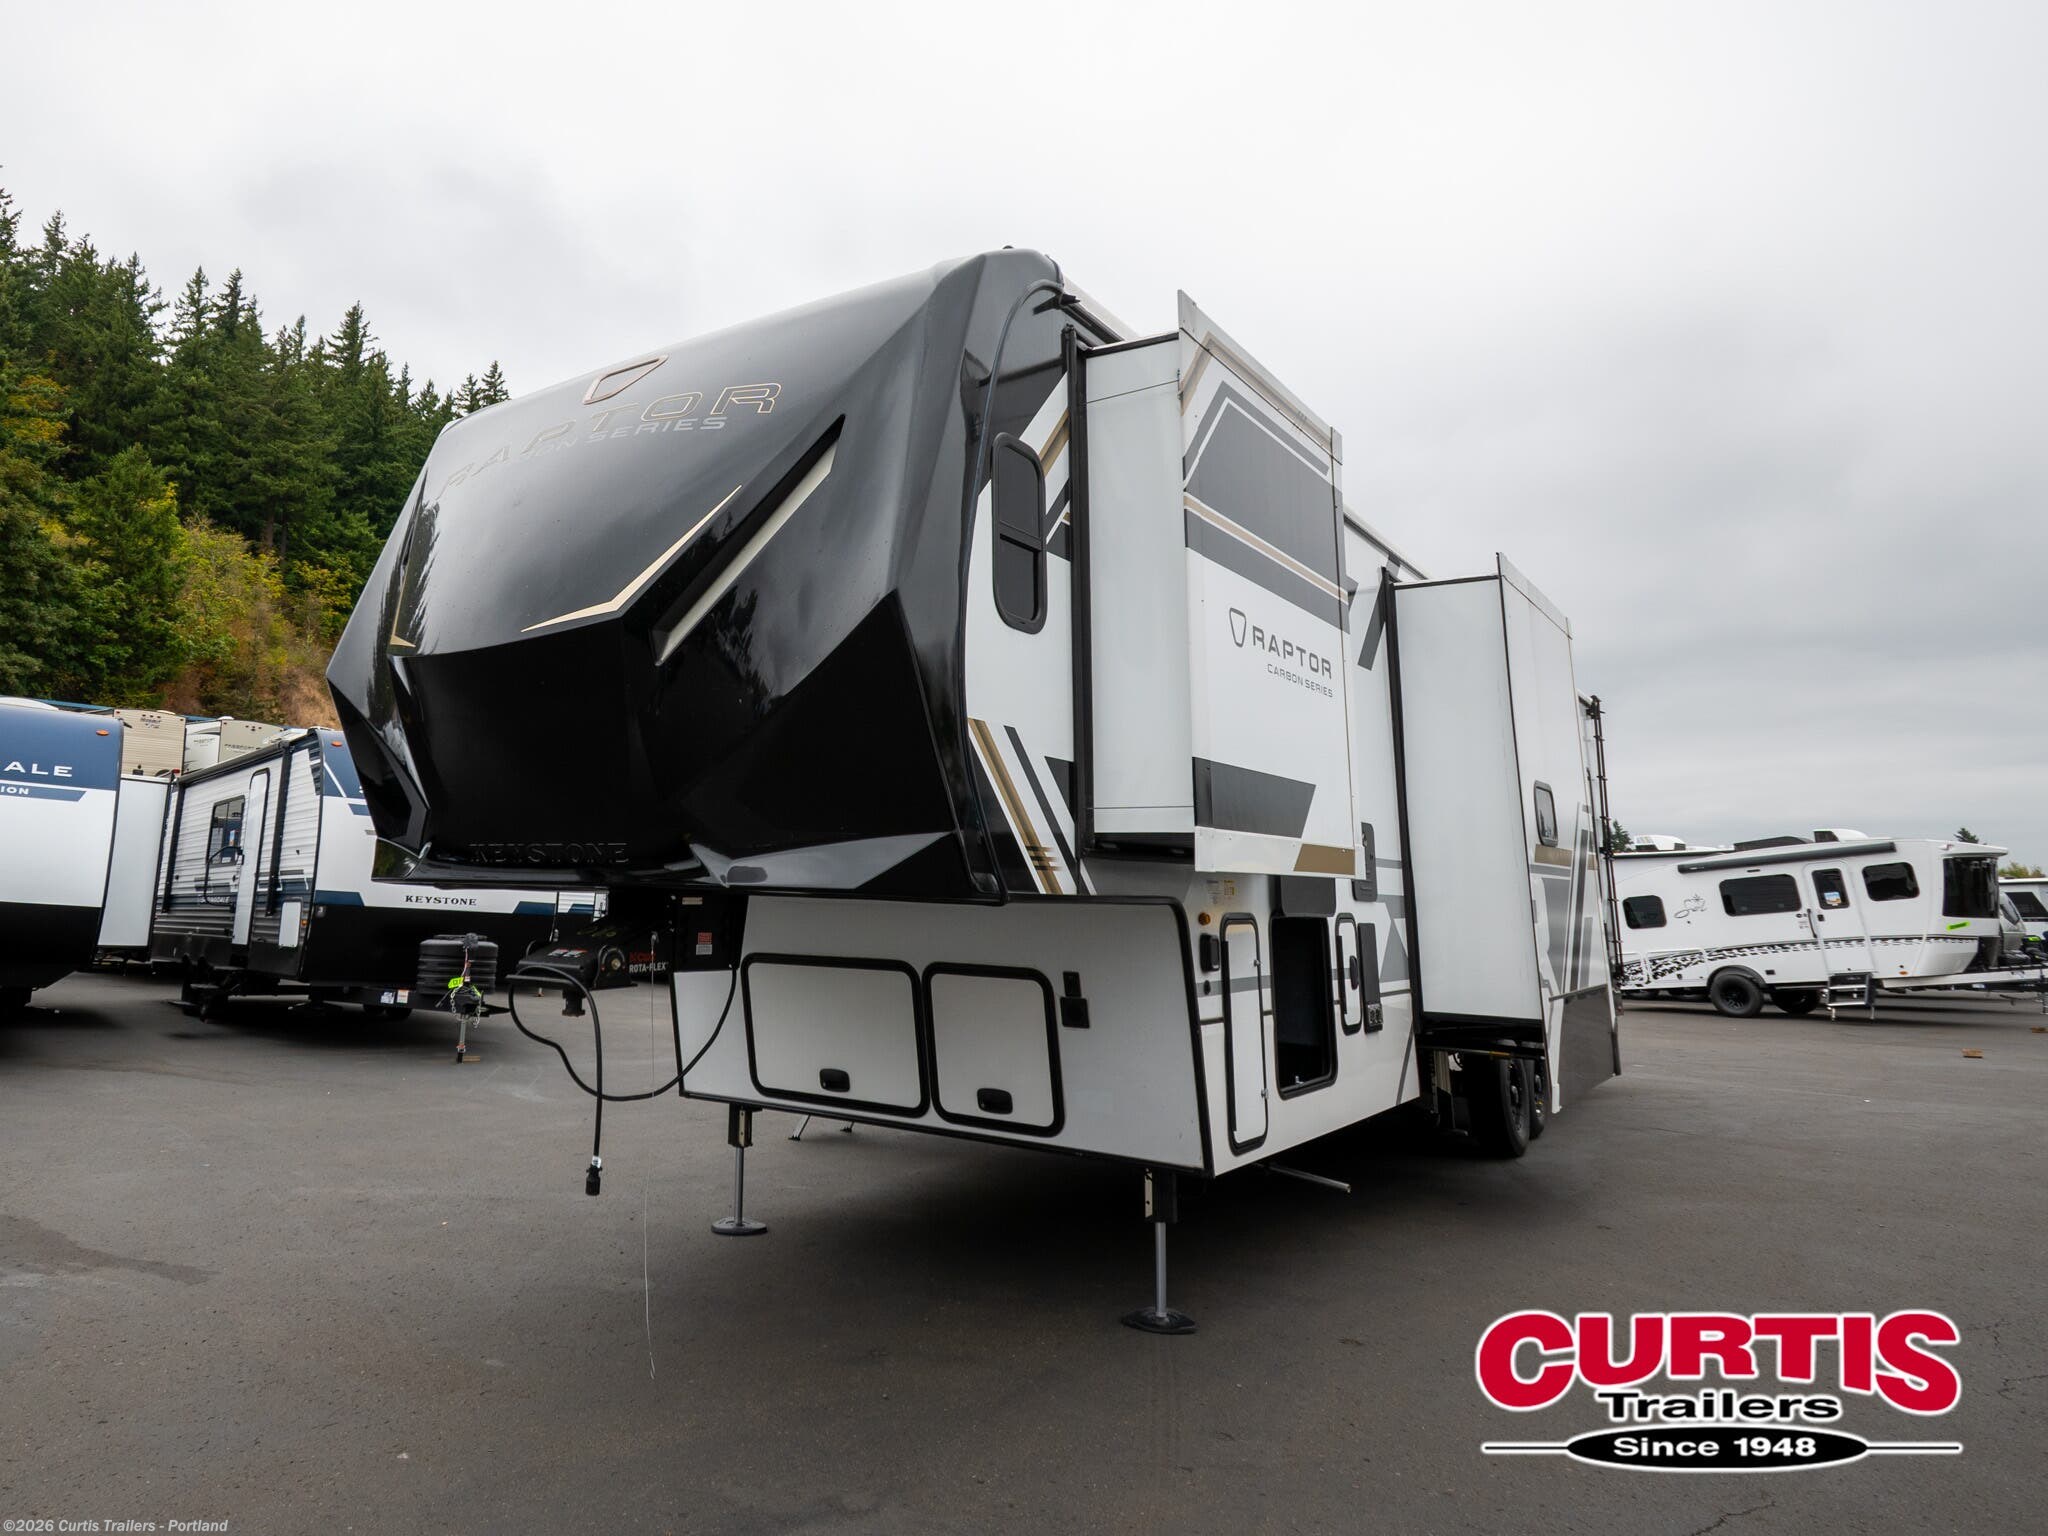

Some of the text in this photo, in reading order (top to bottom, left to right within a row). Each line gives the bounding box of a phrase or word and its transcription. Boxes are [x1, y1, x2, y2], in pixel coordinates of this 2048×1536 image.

[583, 416, 728, 445] SERIES
[1252, 624, 1332, 680] RAPTOR
[1266, 662, 1334, 698] CARBON SERIES
[468, 842, 630, 864] KEYSTONE
[404, 894, 477, 906] KEYSTONE
